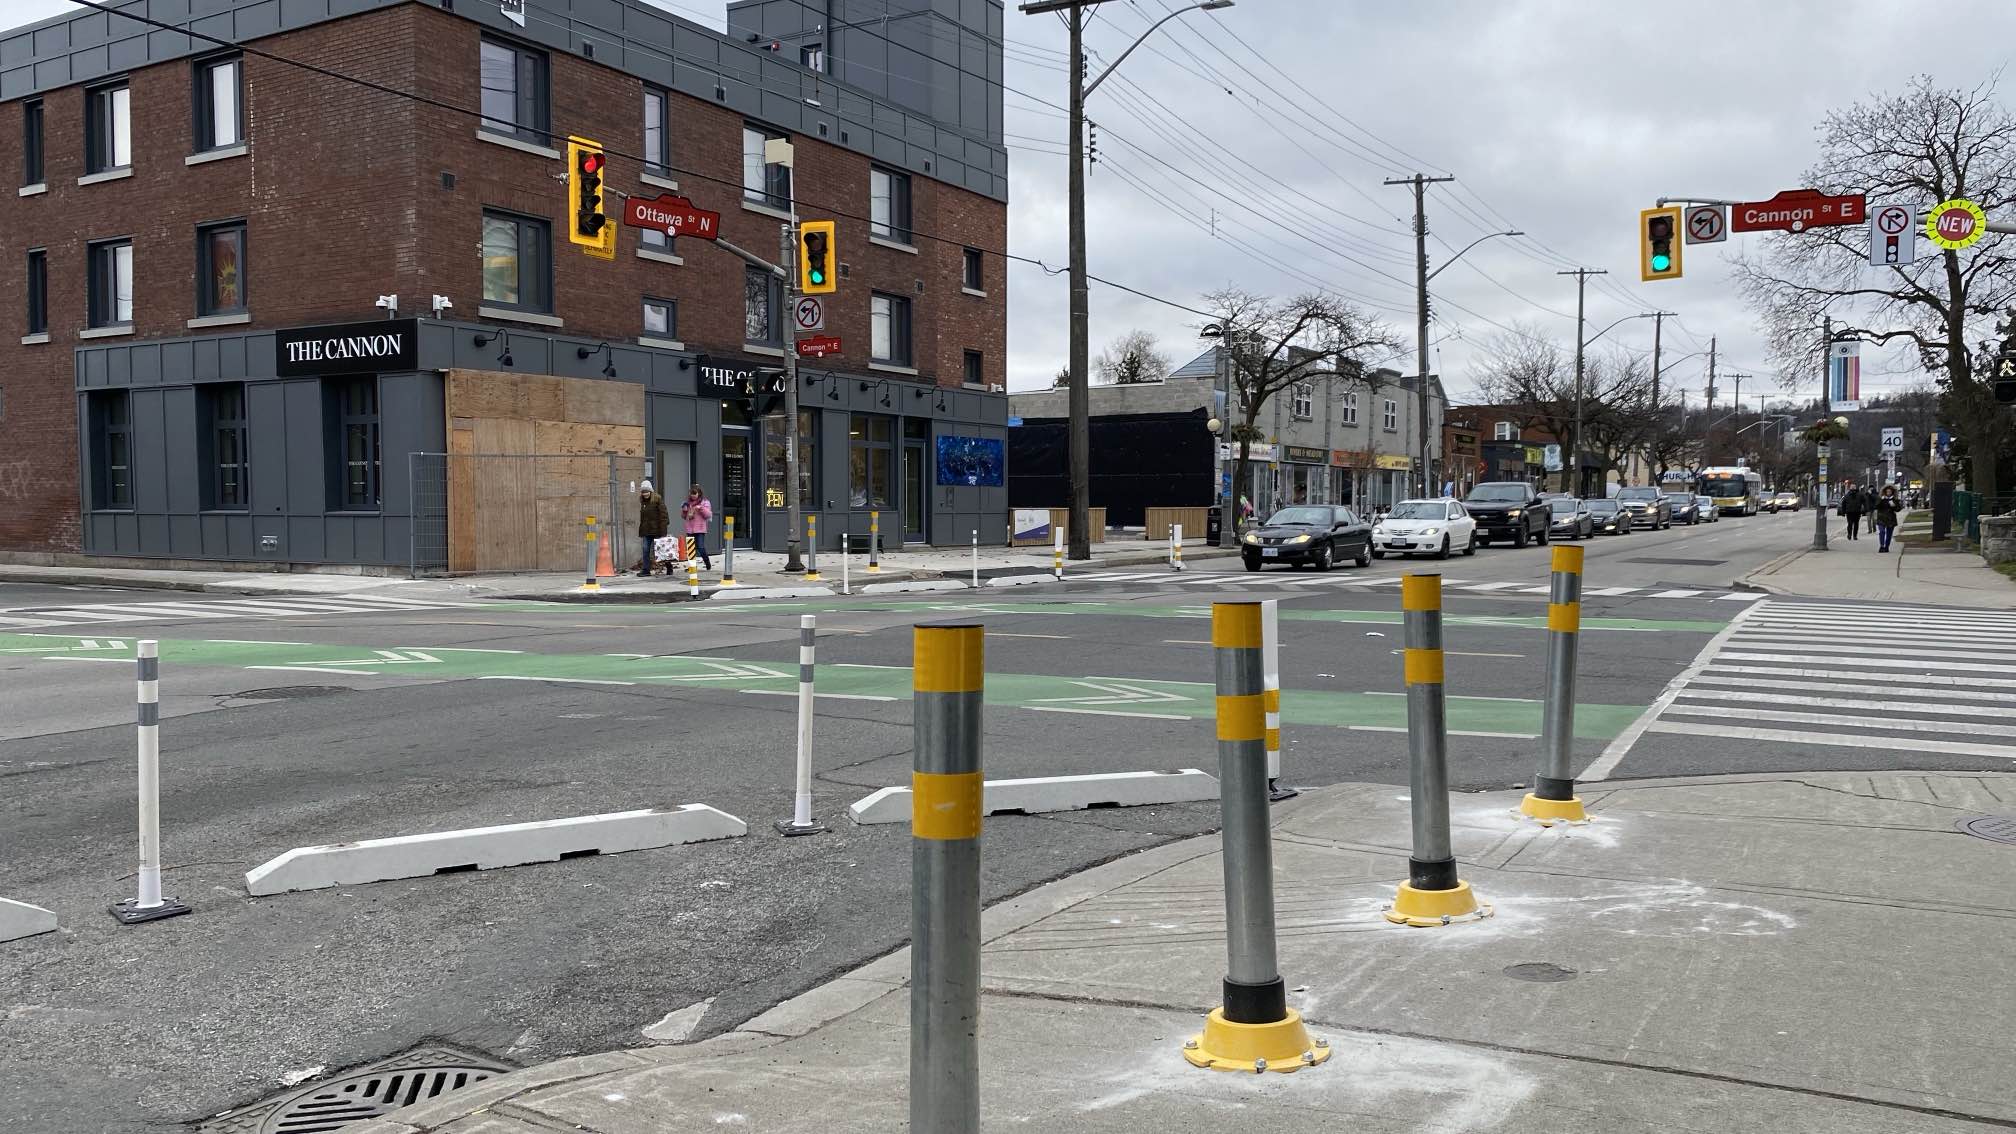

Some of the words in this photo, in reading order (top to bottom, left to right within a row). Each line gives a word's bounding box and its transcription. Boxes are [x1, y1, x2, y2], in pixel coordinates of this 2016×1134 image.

[636, 205, 683, 227] Ottawa
[687, 215, 696, 224] St
[700, 217, 710, 231] N
[1744, 207, 1814, 224] Cannon
[1821, 204, 1833, 213] St
[1840, 202, 1853, 217] E
[1937, 215, 1975, 234] NEW
[286, 340, 323, 362] THE
[325, 333, 402, 360] CANNON
[833, 342, 839, 350] E
[701, 366, 735, 387] THE
[1883, 436, 1902, 447] 40
